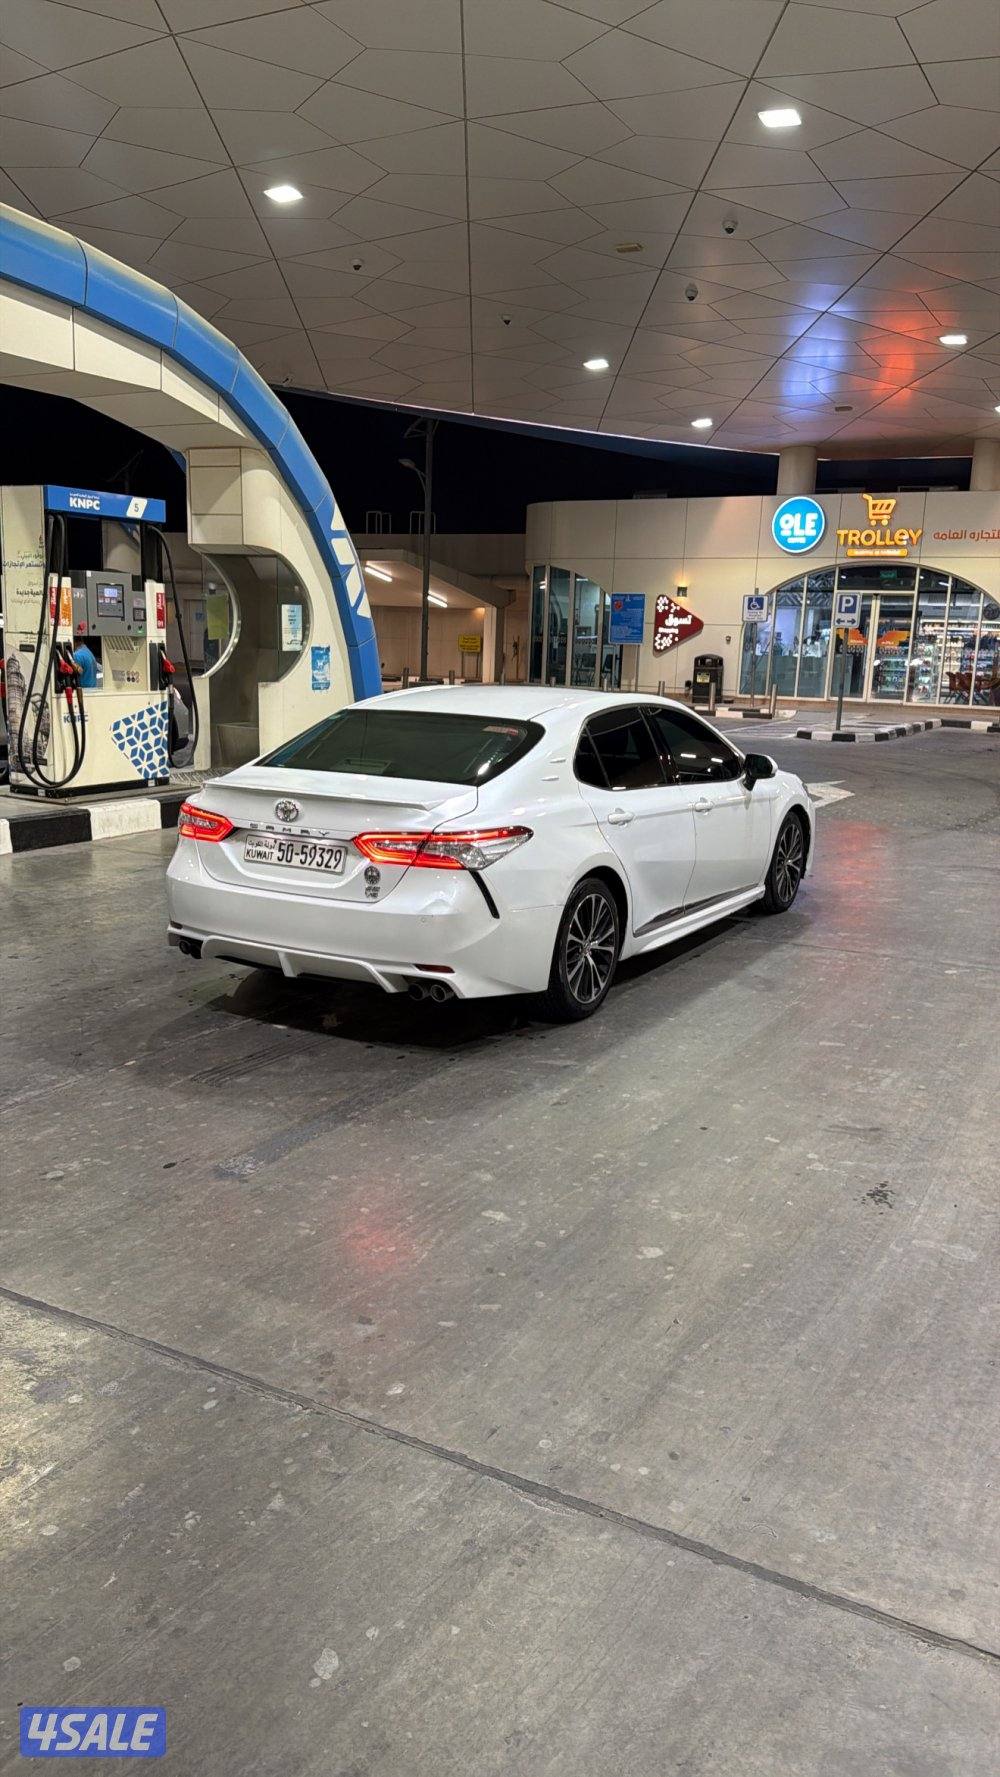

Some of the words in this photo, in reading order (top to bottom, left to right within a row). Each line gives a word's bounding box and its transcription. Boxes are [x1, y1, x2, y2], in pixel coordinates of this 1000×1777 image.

[69, 497, 101, 511] KNPC
[134, 503, 140, 512] 5
[933, 529, 967, 541] العامه
[841, 596, 854, 612] P
[664, 613, 692, 627] تسوق
[245, 849, 275, 861] KUWAIT
[277, 841, 342, 870] 50-59329
